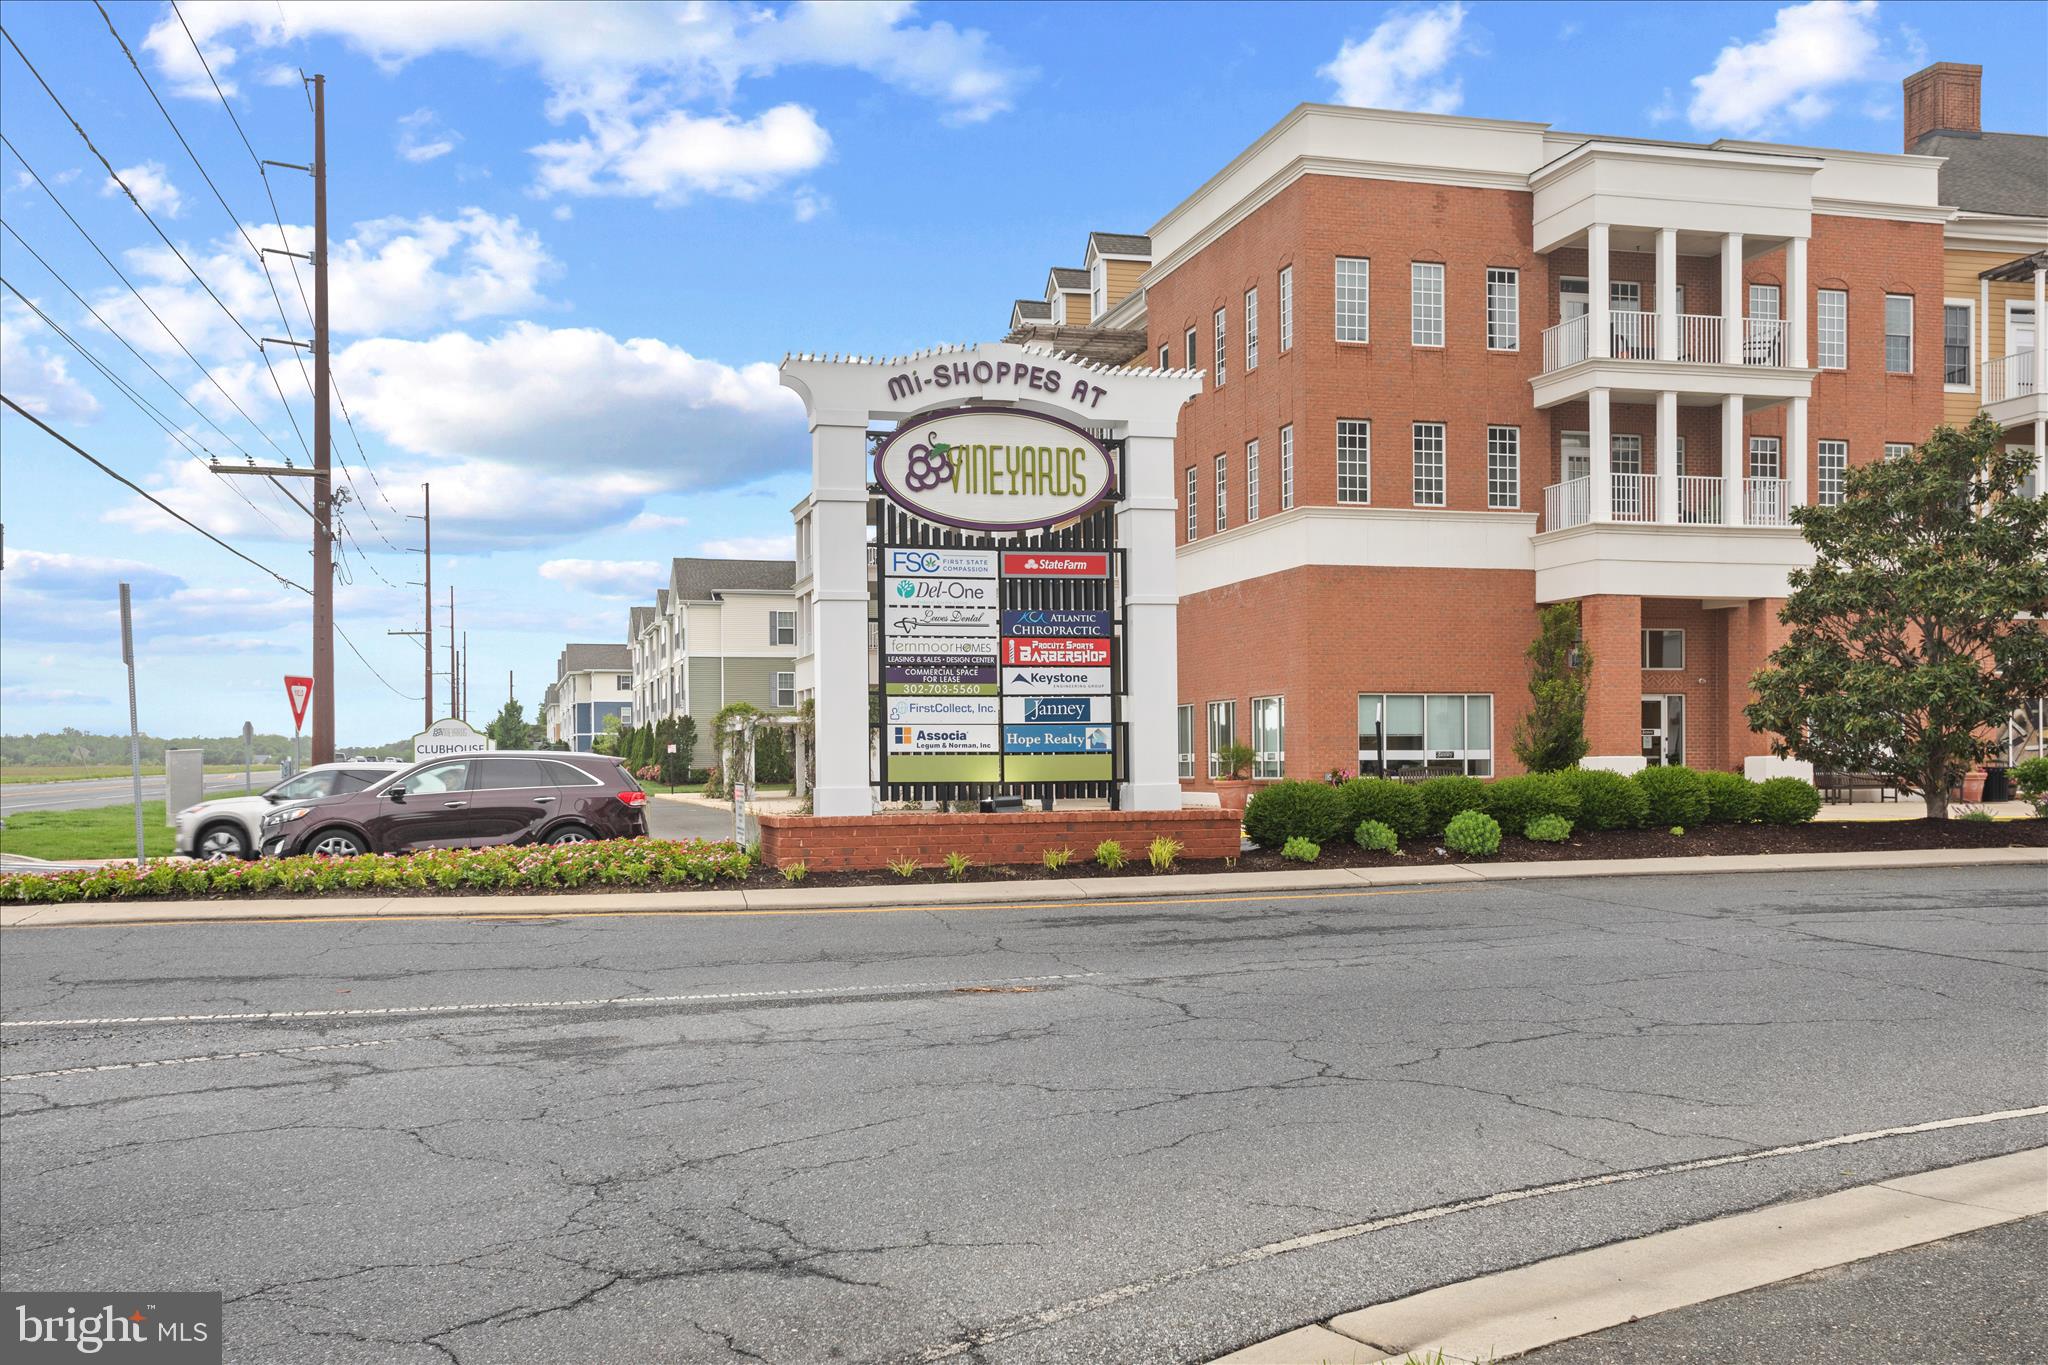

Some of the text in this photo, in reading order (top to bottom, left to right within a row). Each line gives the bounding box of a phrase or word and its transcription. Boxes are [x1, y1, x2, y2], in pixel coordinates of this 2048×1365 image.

[1071, 379, 1107, 408] AT
[946, 444, 1087, 496] VINEYARDS
[893, 552, 940, 573] FSC
[916, 581, 984, 599] Del-One
[950, 610, 985, 622] Dental
[1050, 614, 1096, 623] ATLANTIC
[1012, 624, 1101, 635] CHIROPRACTIC
[1066, 641, 1094, 650] SPORTS
[1020, 646, 1107, 663] BARBERSHOP
[904, 668, 954, 676] COMMERCIAL
[1030, 673, 1088, 684] Keystone
[903, 684, 980, 694] 302-703-5560
[909, 703, 997, 714] FirstCollect, Inc.
[1031, 699, 1085, 720] Janney
[916, 730, 967, 741] Associa
[1007, 733, 1085, 747] Hope Realty
[416, 744, 485, 755] CLUBHOUSE
[916, 742, 940, 750] Legum
